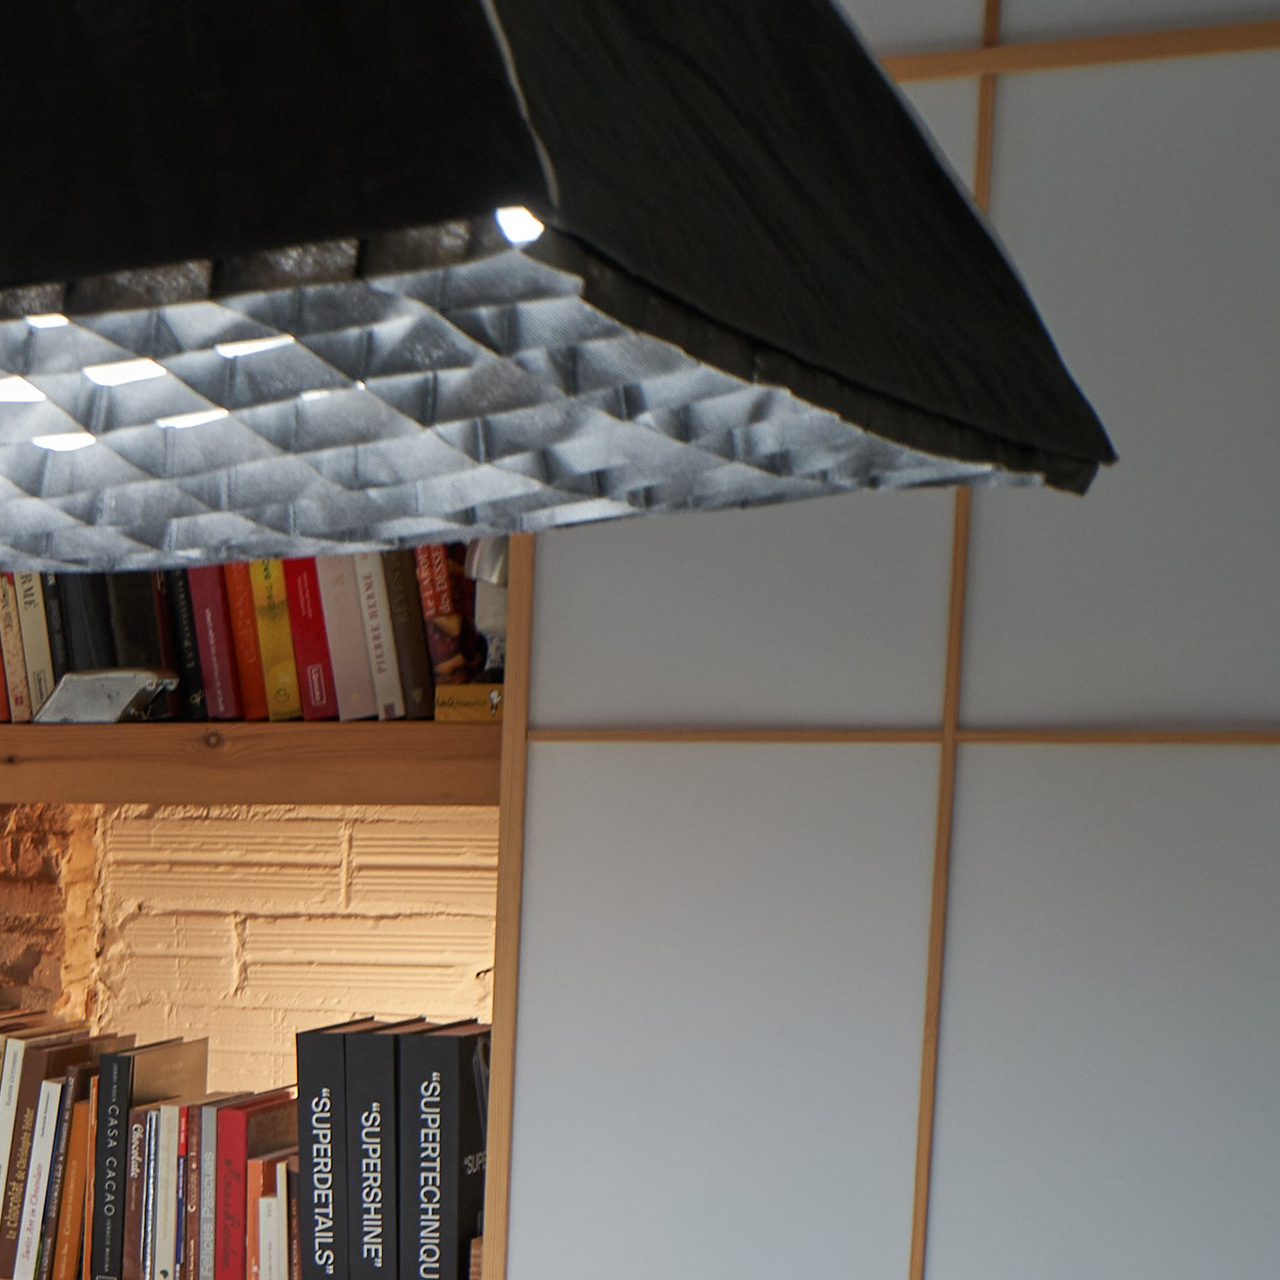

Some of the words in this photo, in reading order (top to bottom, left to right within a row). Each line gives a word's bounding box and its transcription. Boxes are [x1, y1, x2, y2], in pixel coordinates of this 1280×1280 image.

[21, 574, 36, 610] RMÉ
[369, 624, 387, 674] PIERRE
[106, 1104, 120, 1148] CASA
[129, 1123, 144, 1179] Chocolate
[4, 1182, 23, 1228] chocolat
[29, 1164, 44, 1206] Chocolate
[103, 1156, 117, 1216] CACAO
[201, 1151, 215, 1218] Pascuas
[311, 1087, 334, 1274] “SUPERDETAILS”
[361, 1102, 383, 1267] “SUPERSHINE”
[201, 1223, 214, 1277] Felices
